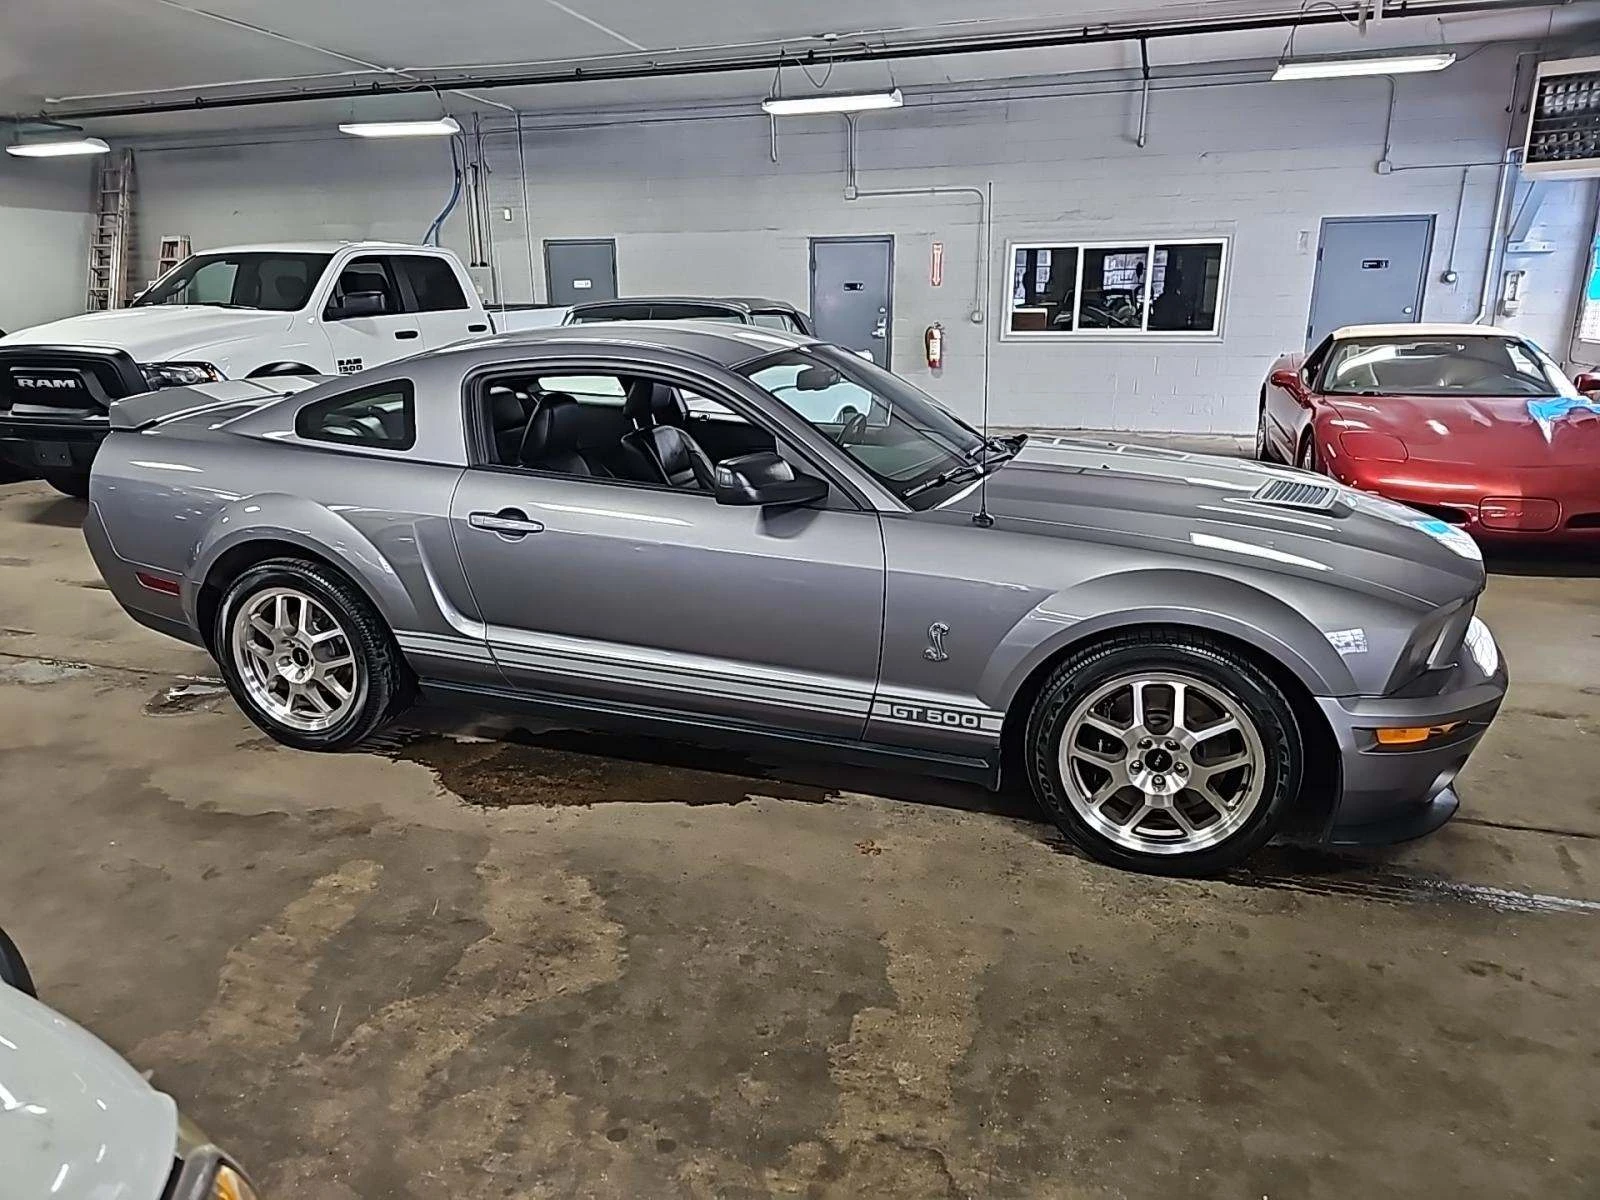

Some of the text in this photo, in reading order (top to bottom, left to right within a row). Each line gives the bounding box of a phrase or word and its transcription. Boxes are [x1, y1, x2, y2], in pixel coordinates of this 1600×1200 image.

[337, 358, 363, 366] RAM
[17, 378, 76, 389] RAM
[892, 705, 979, 728] GT 500
